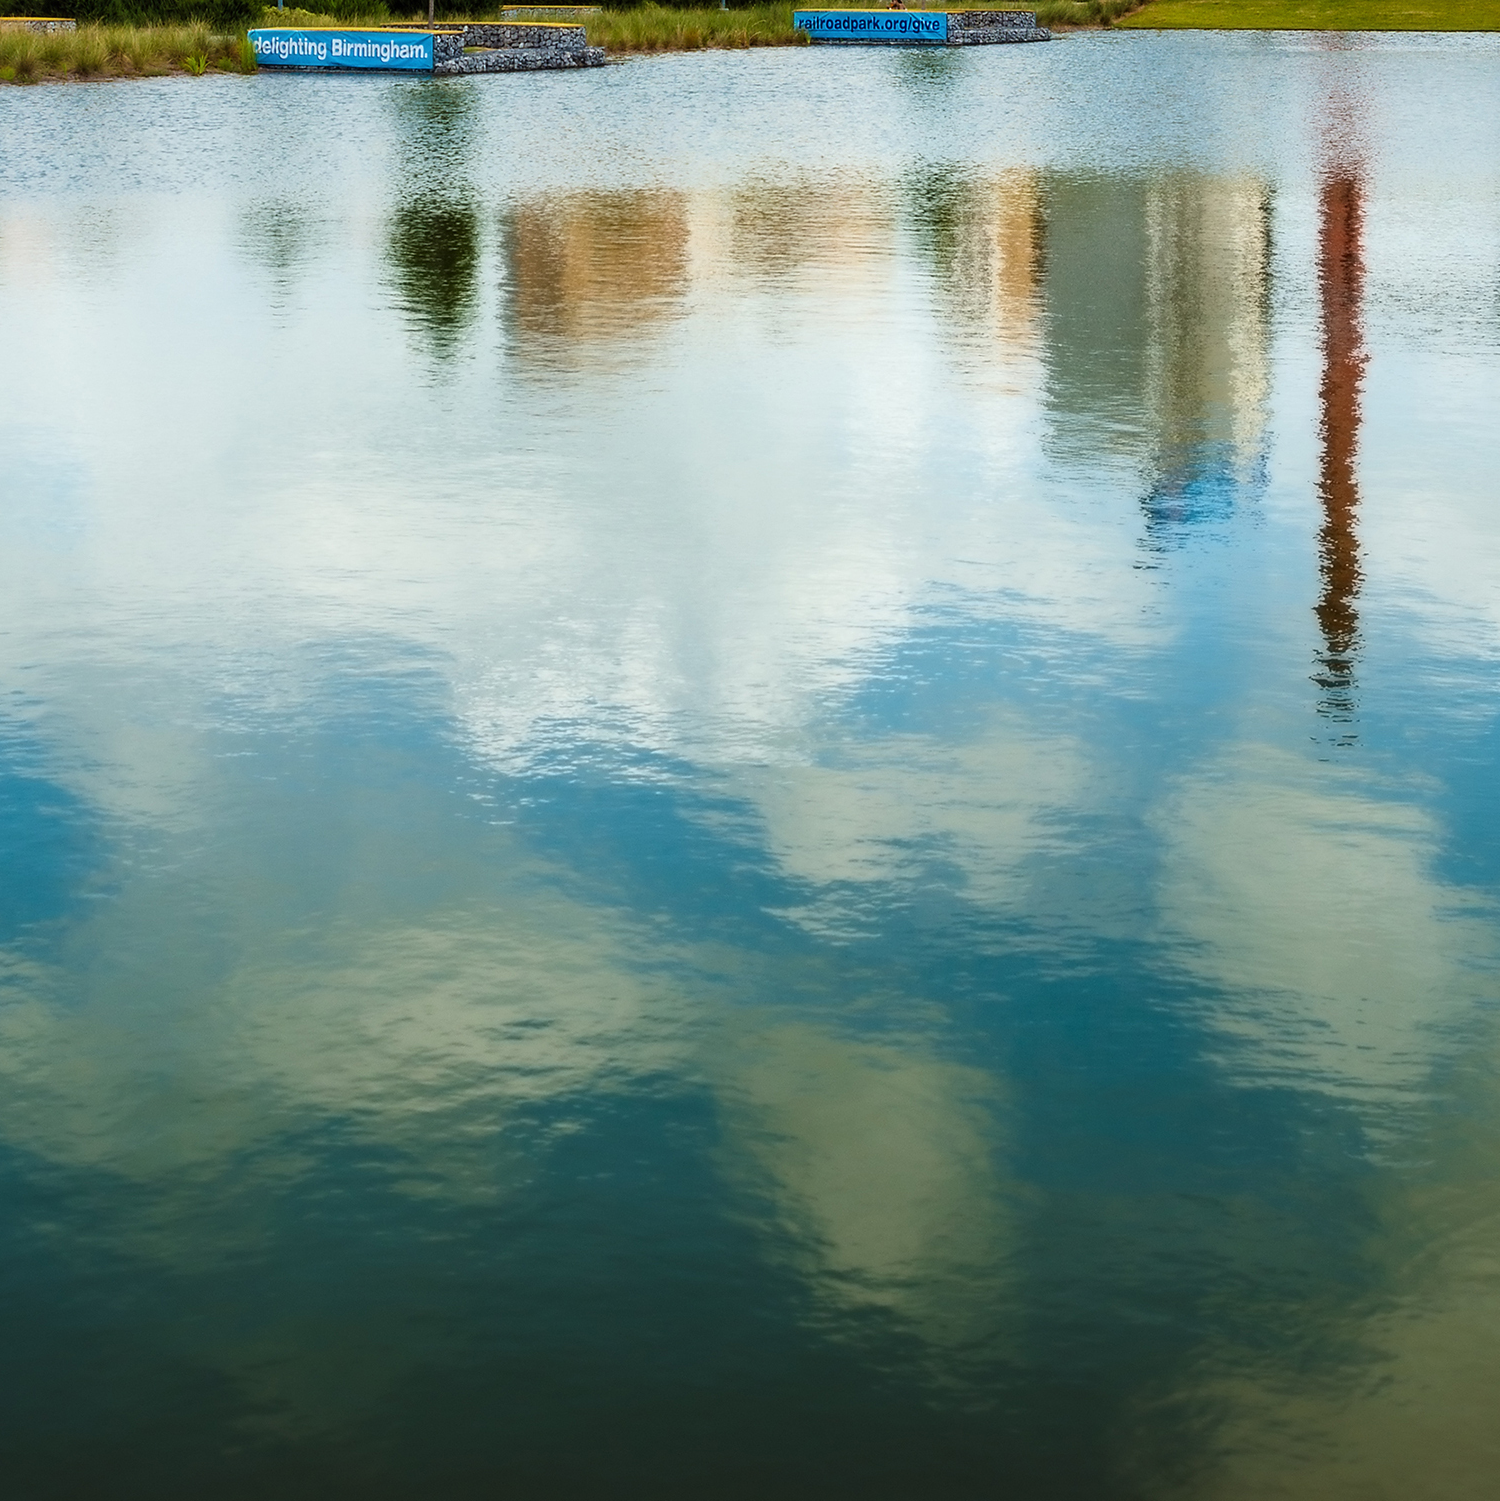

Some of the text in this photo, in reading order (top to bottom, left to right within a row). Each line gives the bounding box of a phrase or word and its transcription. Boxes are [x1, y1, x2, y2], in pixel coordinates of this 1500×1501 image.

[798, 16, 940, 33] railroadpark.org/give
[253, 37, 428, 63] delighting Birmingham.
